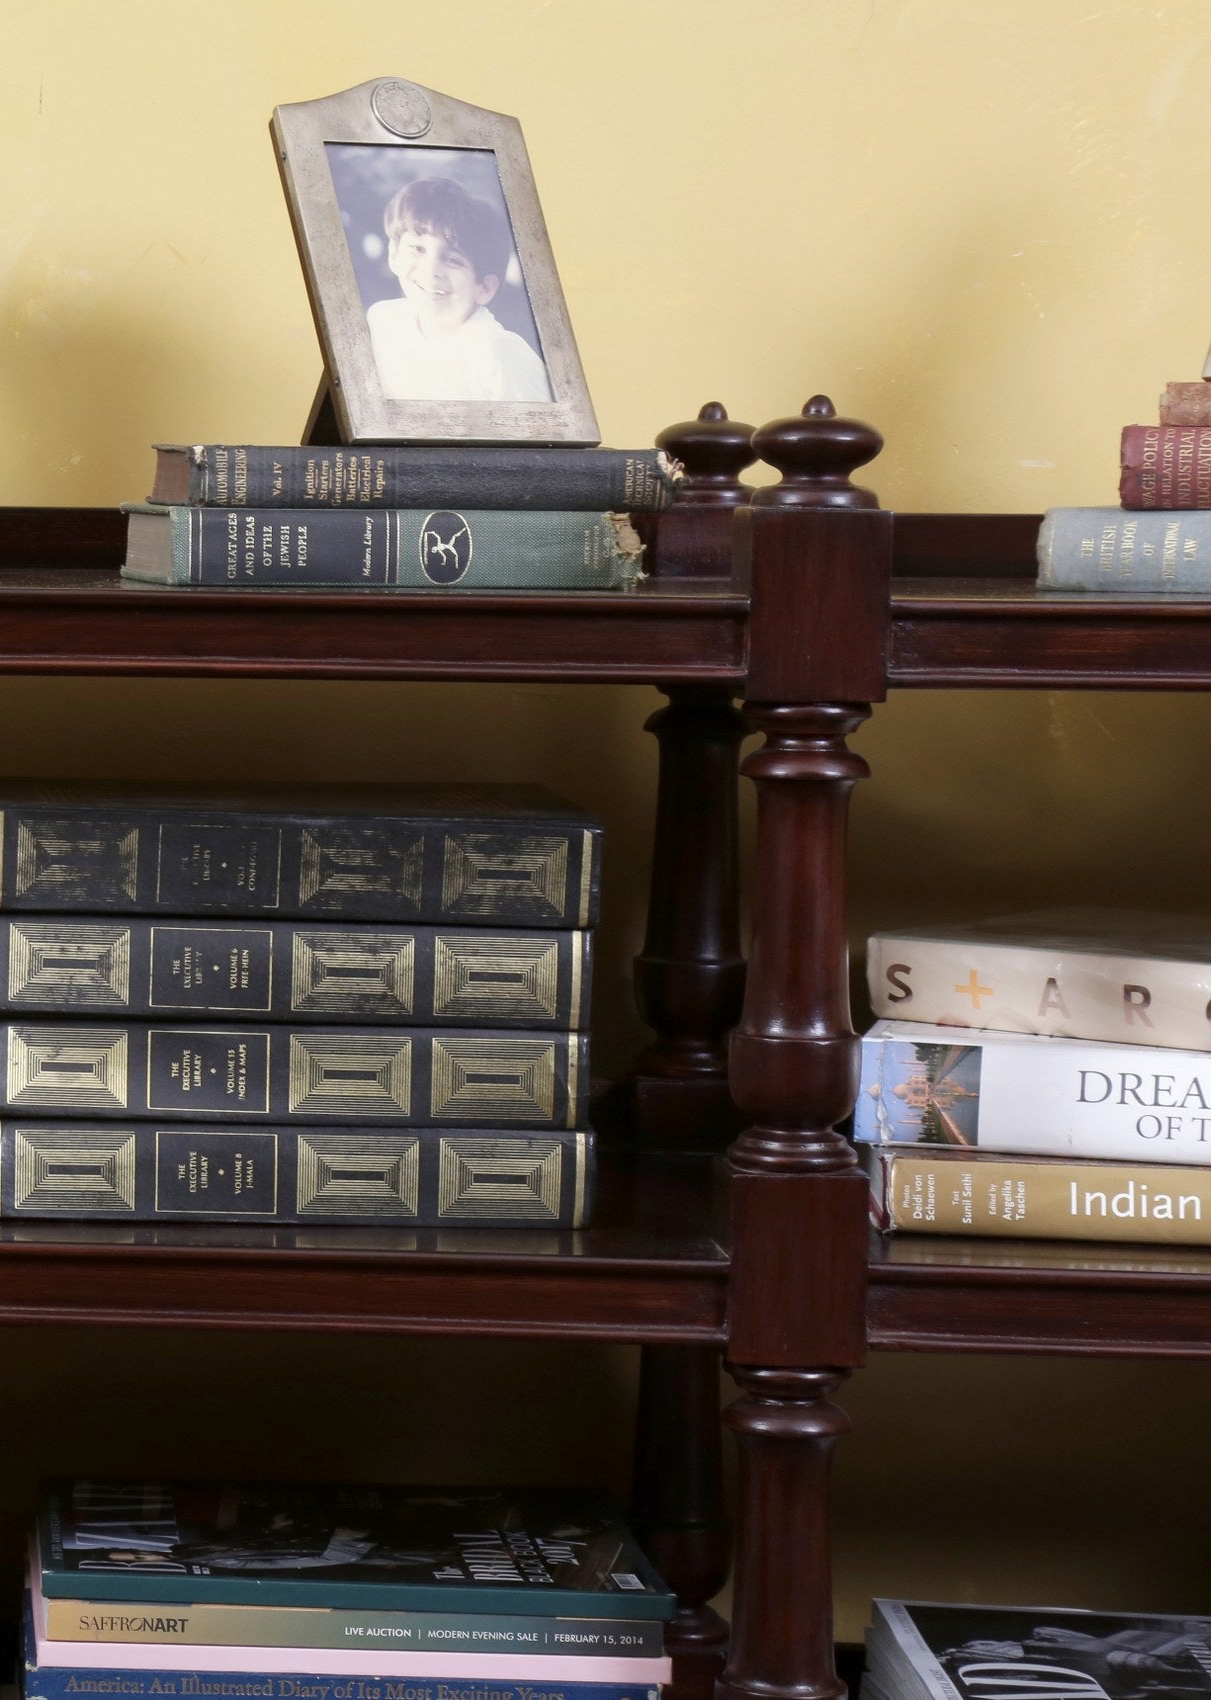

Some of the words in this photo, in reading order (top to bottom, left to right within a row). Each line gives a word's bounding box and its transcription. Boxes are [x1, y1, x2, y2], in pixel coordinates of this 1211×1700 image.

[1165, 429, 1177, 441] TO
[215, 448, 229, 506] AUTOMOBILE
[231, 448, 247, 506] ENGINEERING
[274, 462, 284, 475] IV
[304, 459, 316, 500] Ignition
[319, 460, 329, 501] Starters
[332, 452, 343, 506] Generators
[346, 456, 358, 501] Batteries
[360, 455, 371, 502] Electrical
[373, 459, 385, 499] Repairs
[1162, 442, 1174, 495] RELATION
[1178, 429, 1196, 505] INDUSTRIAL
[273, 477, 284, 497] Vol.
[228, 512, 238, 540] AGES
[245, 516, 255, 549] IDEAS
[263, 525, 274, 550] THE
[363, 516, 374, 547] Library
[1121, 520, 1139, 549] BOOK
[228, 541, 237, 579] GREAT
[263, 551, 273, 567] OF
[280, 525, 291, 568] JEWISH
[298, 526, 308, 567] PEOPLE
[1080, 537, 1095, 558] THE
[1099, 525, 1117, 573] BRITISH
[1143, 541, 1155, 556] OF
[1183, 537, 1198, 561] LAW
[245, 552, 255, 576] AND
[362, 548, 373, 577] Modern
[173, 959, 181, 975] THE
[183, 946, 192, 989] EXECUTIVE
[229, 955, 239, 990] VOLUME
[171, 1061, 180, 1078] THE
[182, 1049, 191, 1091] EXECUTIVE
[239, 1043, 247, 1066] MAPS
[193, 1054, 202, 1087] LIBRARY
[226, 1060, 235, 1094] VOLUME
[238, 1076, 247, 1100] INDEX
[1076, 1070, 1211, 1110] DREA
[1135, 1114, 1183, 1140] OF
[178, 1164, 186, 1180] THE
[189, 1151, 197, 1193] EXECUTIVE
[201, 1155, 209, 1189] LIBRARY
[234, 1160, 243, 1195] VOLUME
[914, 1174, 923, 1189] von
[963, 1172, 973, 1200] Sethi
[925, 1173, 935, 1222] Schaewen
[952, 1190, 960, 1206] Text
[989, 1183, 999, 1193] by
[1002, 1179, 1013, 1221] Angelika
[1015, 1180, 1025, 1220] Taschen
[1070, 1180, 1203, 1222] Indian
[913, 1192, 923, 1220] Deidi
[962, 1200, 973, 1225] Sunil
[989, 1194, 998, 1216] Edited
[453, 1529, 525, 1582] BRIDAL
[503, 1530, 537, 1556] BOOK
[535, 1537, 588, 1566] 2017
[518, 1559, 555, 1583] BLACK
[79, 1615, 189, 1634] SAFFRONART
[345, 1626, 365, 1637] LIVE
[366, 1627, 412, 1638] AUCTION
[427, 1629, 470, 1640] MODERN
[472, 1630, 515, 1642] EVENING
[516, 1632, 539, 1642] SALE
[554, 1633, 600, 1644] FEBRUARY
[602, 1634, 618, 1646] 15,
[619, 1635, 644, 1645] 2014
[64, 1674, 145, 1694] America:
[147, 1677, 177, 1694] An
[180, 1677, 275, 1697] Illustrated
[277, 1680, 332, 1700] Diary
[333, 1680, 356, 1699] of
[357, 1681, 381, 1700] Its
[385, 1682, 432, 1700] Most
[436, 1684, 514, 1700] Exciting
[514, 1686, 566, 1700] Years
